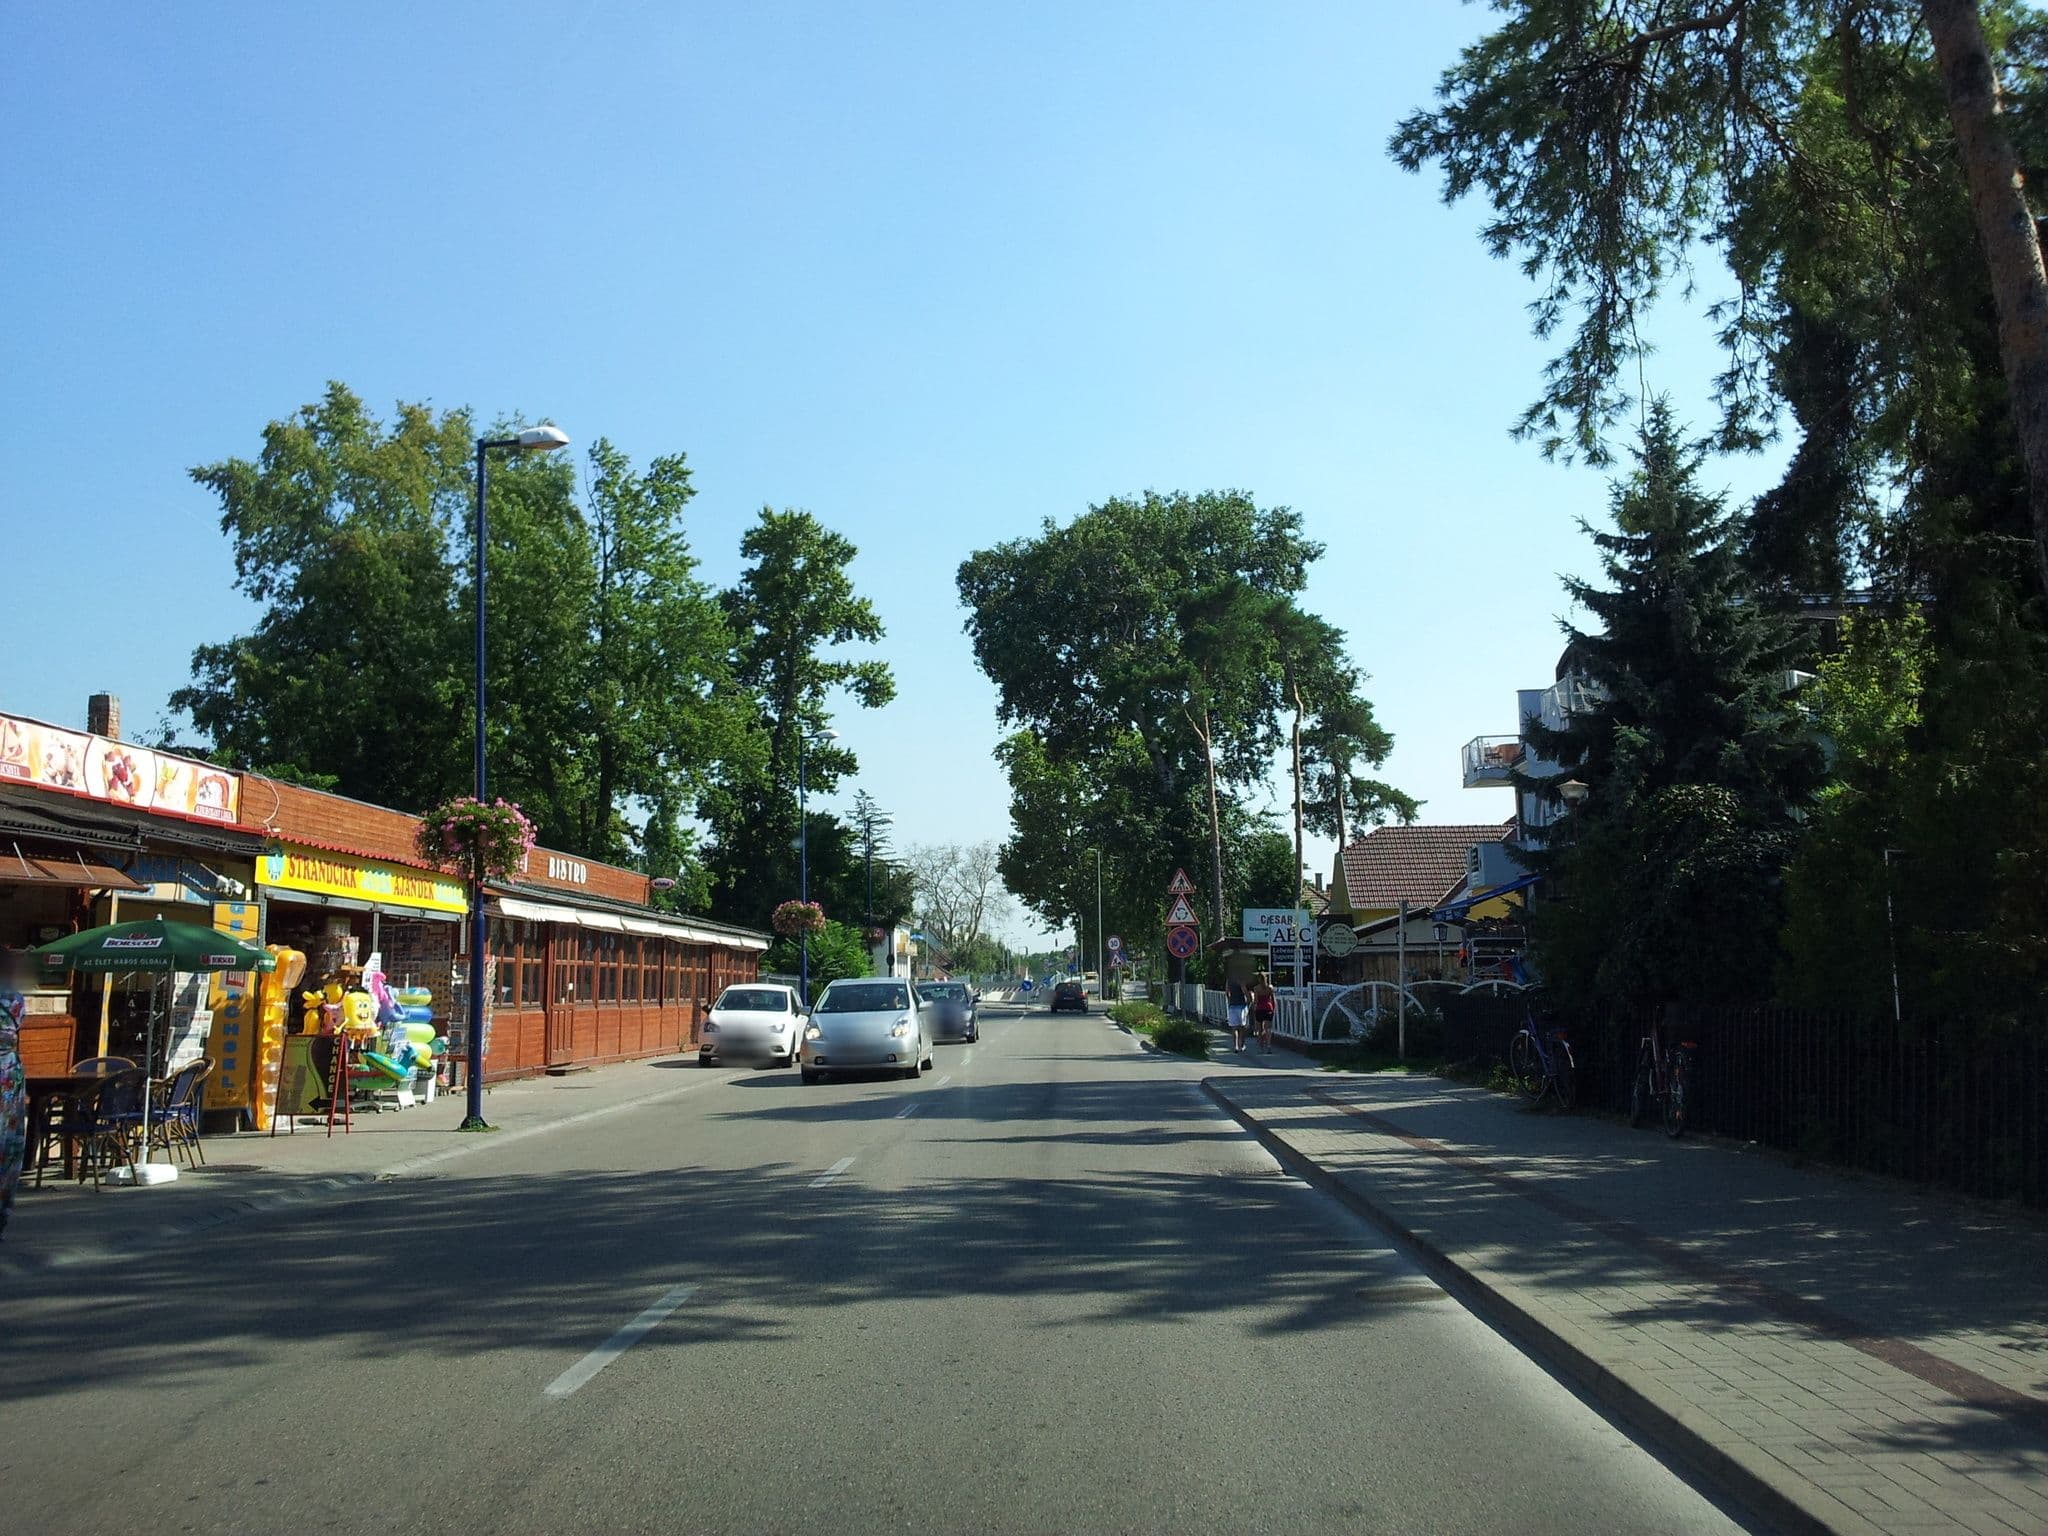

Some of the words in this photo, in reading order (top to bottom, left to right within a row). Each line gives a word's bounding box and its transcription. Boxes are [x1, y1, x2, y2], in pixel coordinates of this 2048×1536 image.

[548, 856, 588, 885] BISTRO
[1271, 928, 1312, 942] ABC
[327, 1037, 341, 1093] CHANGE
